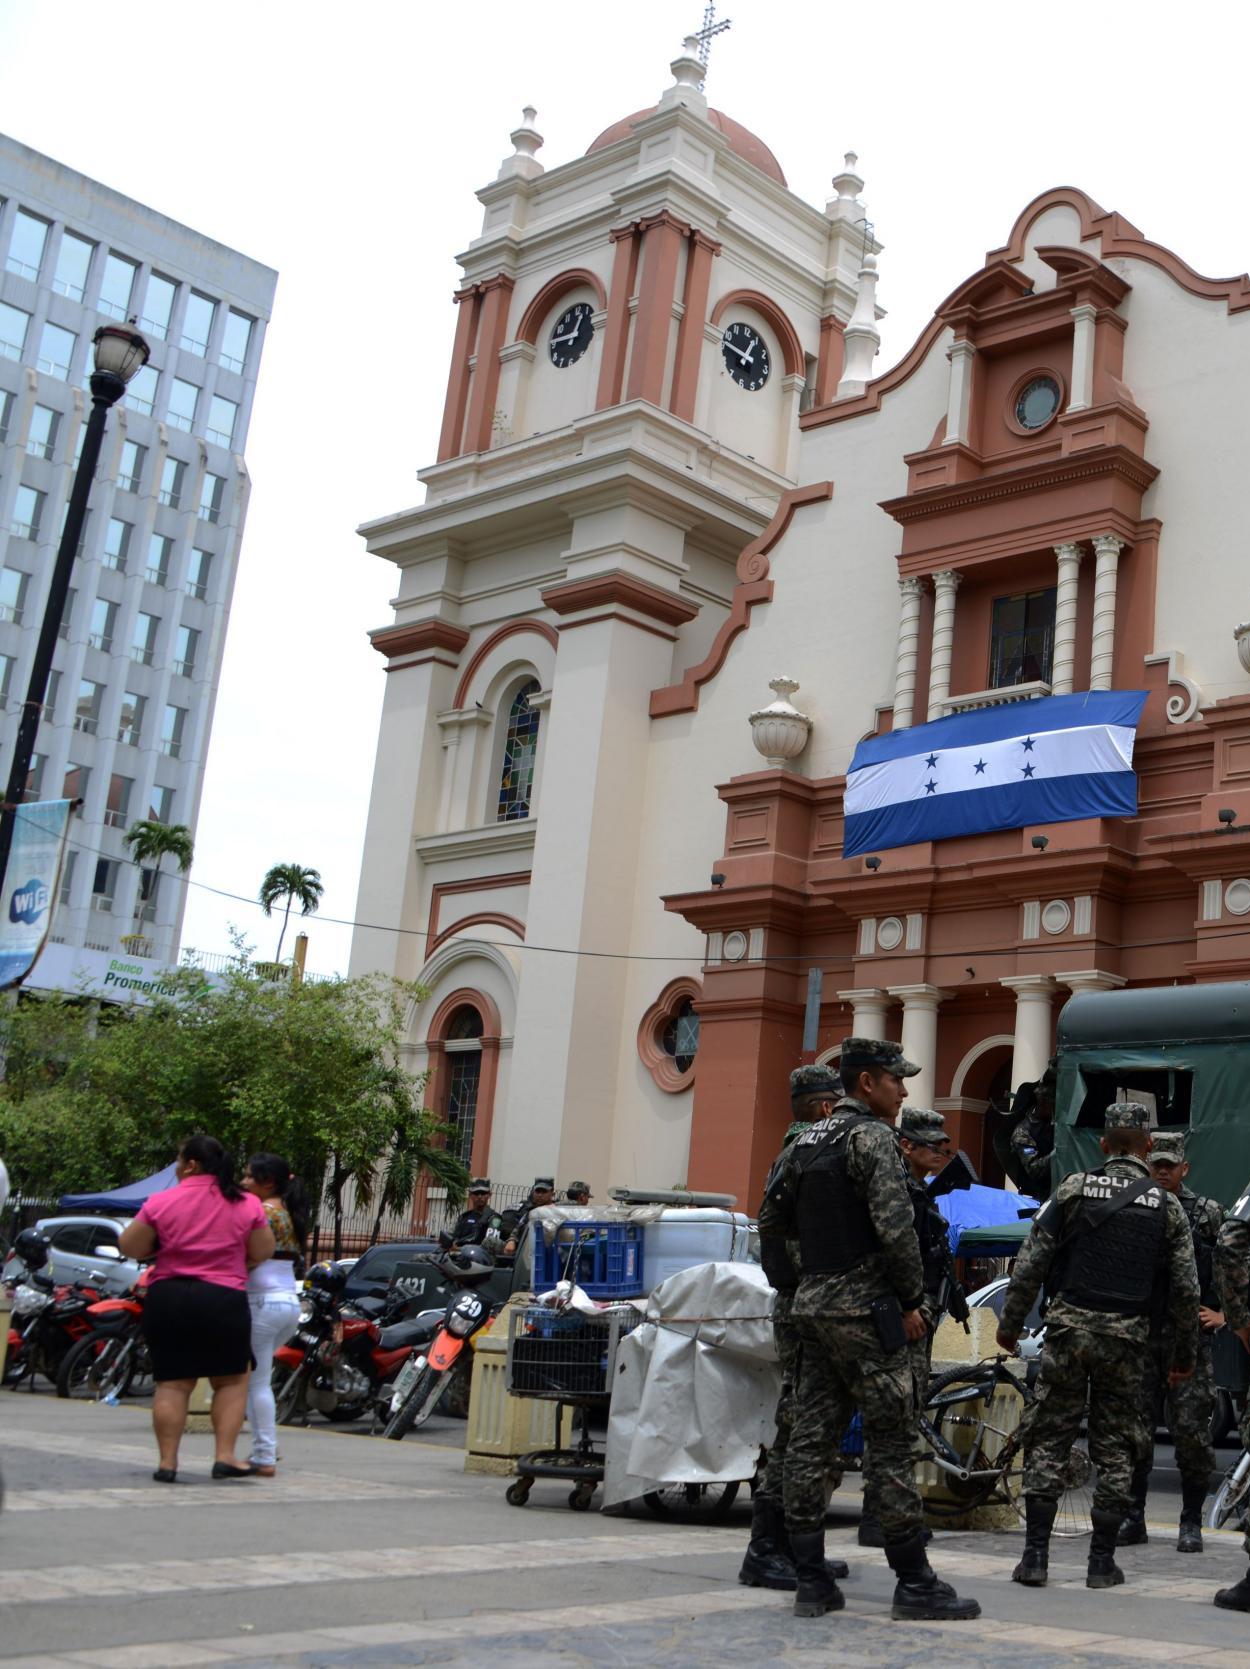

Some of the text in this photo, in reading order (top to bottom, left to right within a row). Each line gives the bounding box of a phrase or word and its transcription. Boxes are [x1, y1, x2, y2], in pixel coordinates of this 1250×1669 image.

[585, 306, 590, 315] 1
[565, 313, 571, 323] 11
[557, 324, 564, 334] 10
[733, 324, 740, 335] 11
[744, 326, 752, 338] 12
[725, 330, 733, 341] 10
[552, 352, 558, 362] 8
[761, 349, 767, 360] 2
[560, 357, 565, 368] 7
[730, 369, 735, 377] 7
[762, 365, 769, 375] 3
[738, 378, 745, 389] 6
[750, 381, 756, 391] 5
[758, 377, 764, 386] 4
[109, 960, 144, 975] Banco
[104, 972, 178, 997] Promerica
[1085, 1174, 1161, 1196] POLIA
[1083, 1186, 1160, 1209] MILAR
[456, 1295, 482, 1318] 29
